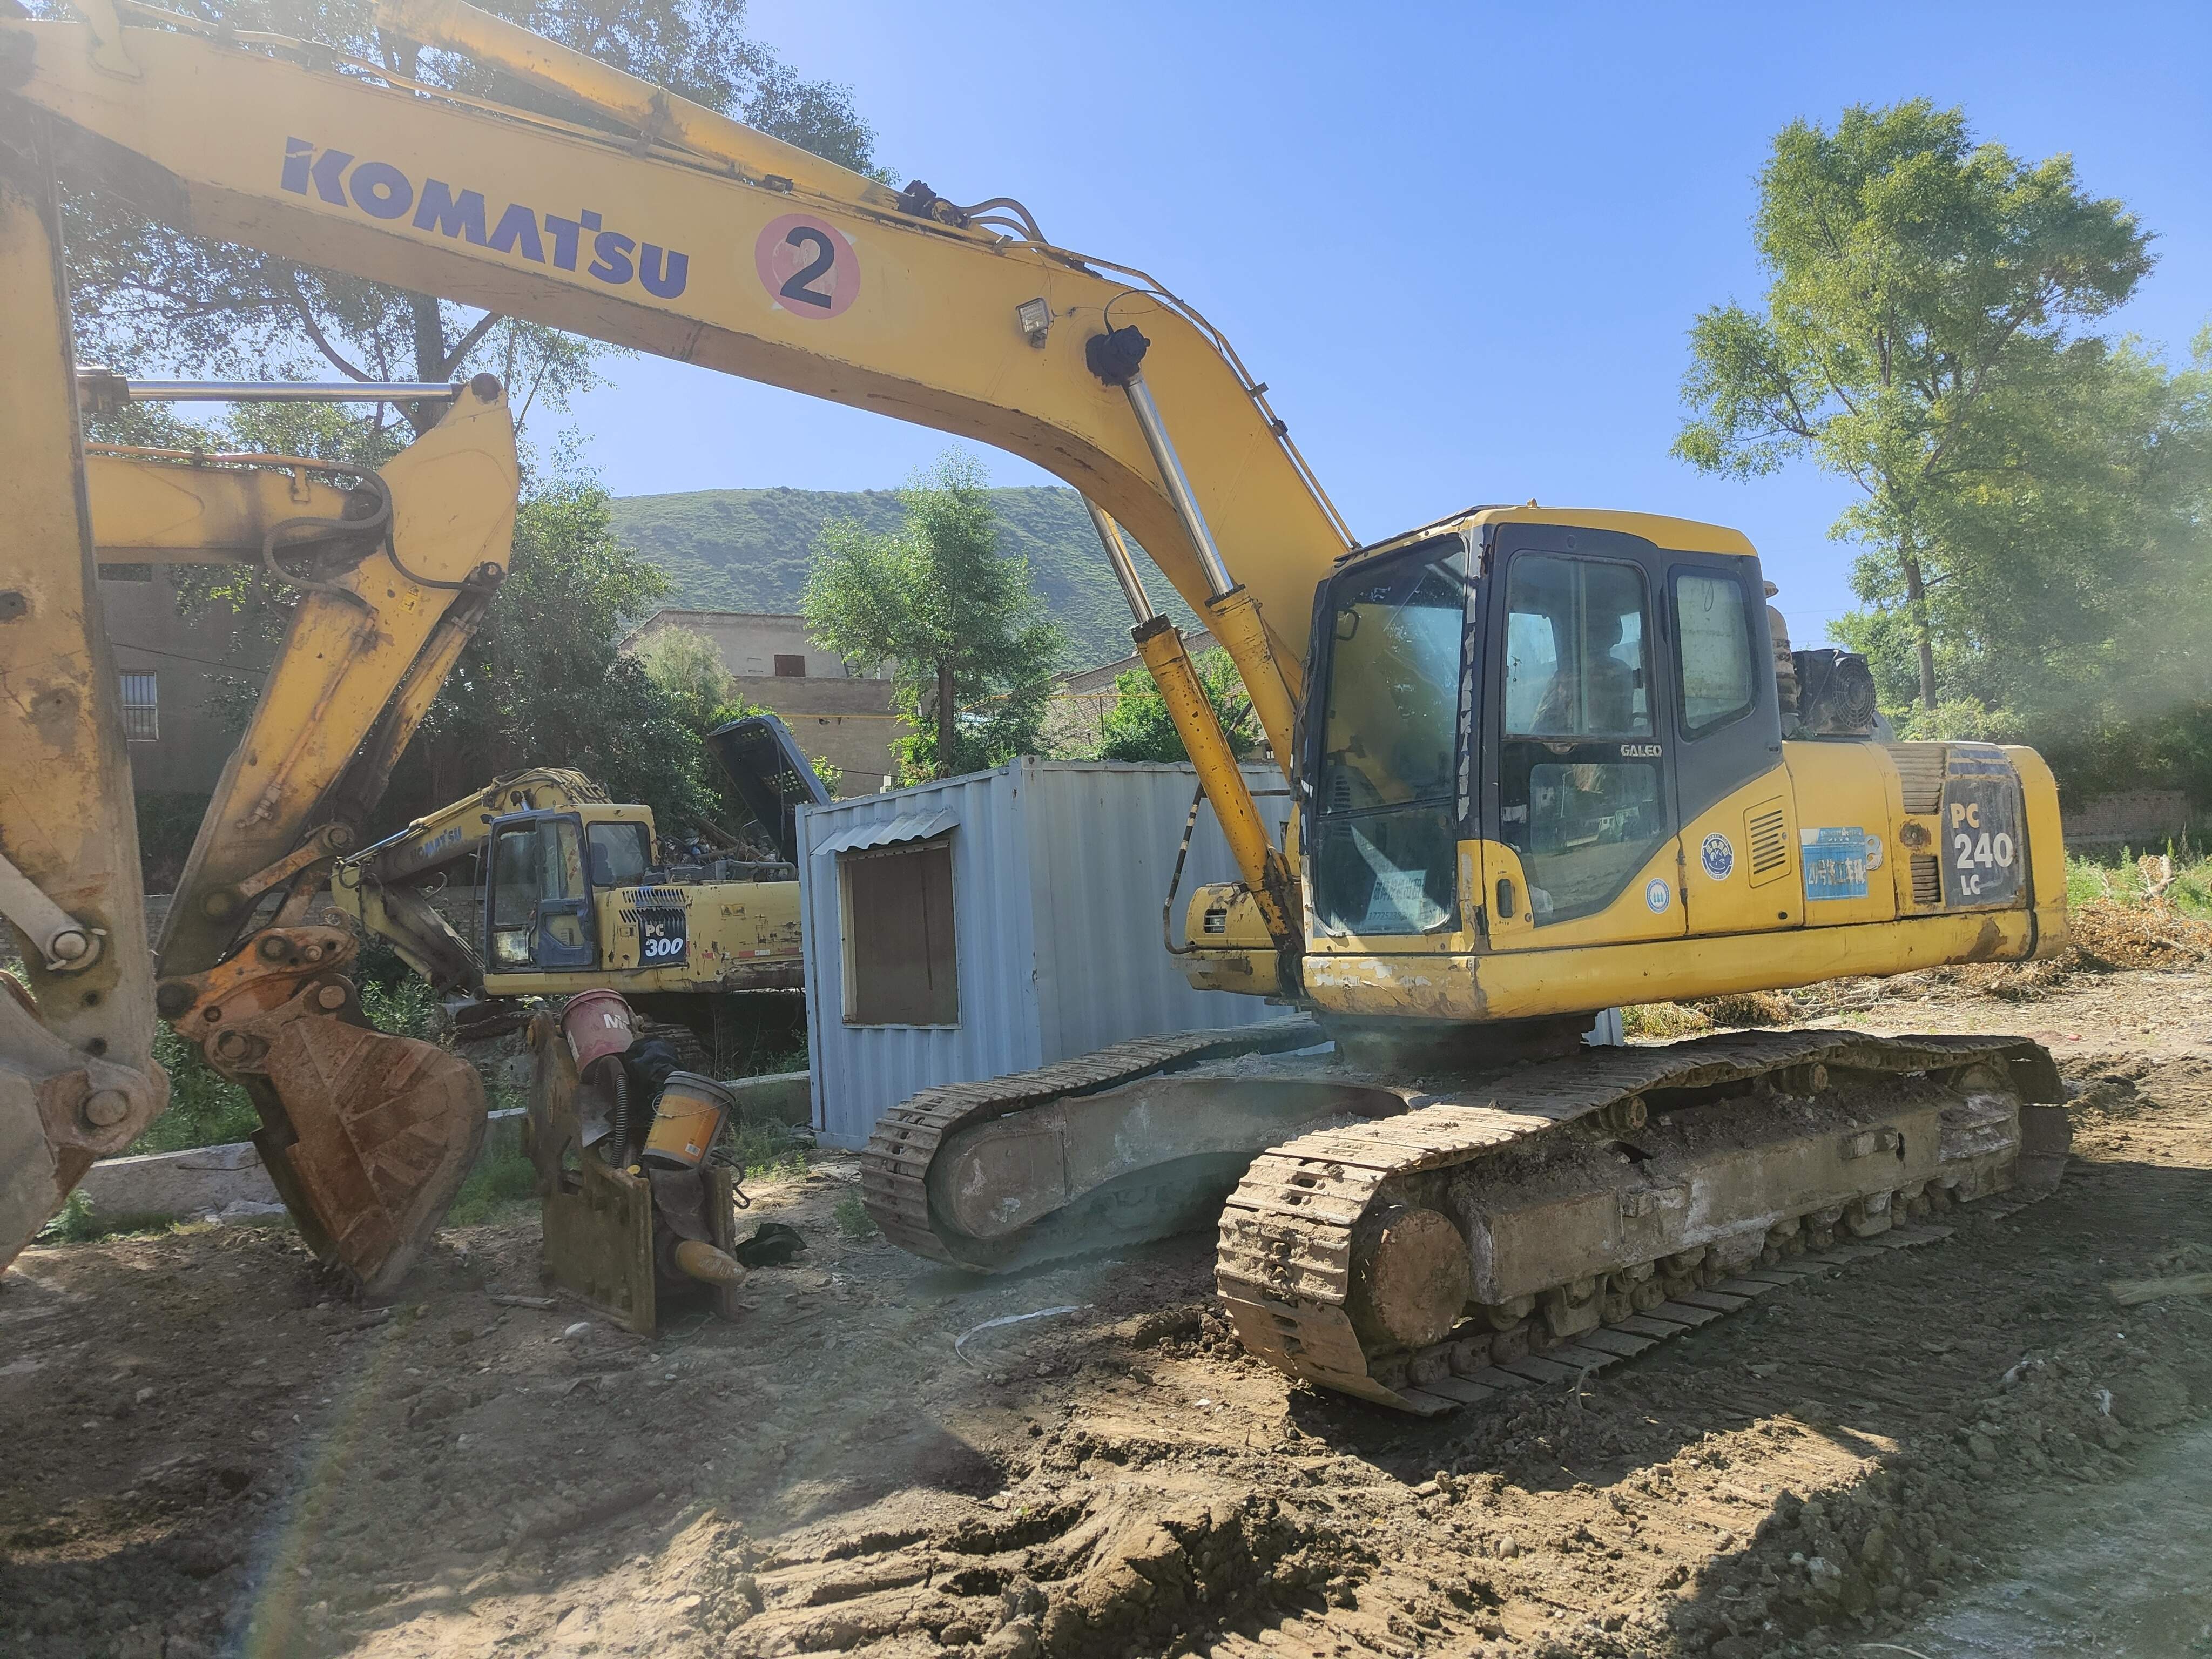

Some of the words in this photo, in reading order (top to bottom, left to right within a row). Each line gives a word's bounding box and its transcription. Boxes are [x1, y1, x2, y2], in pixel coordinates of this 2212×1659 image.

[279, 136, 690, 300] KOMATSU
[779, 226, 836, 309] 2
[1620, 745, 1662, 757] GALEO
[1950, 802, 1979, 828] PC
[1954, 833, 2014, 869] 240
[1960, 874, 1981, 895] LC
[645, 923, 664, 937] PC
[645, 938, 684, 957] 300
